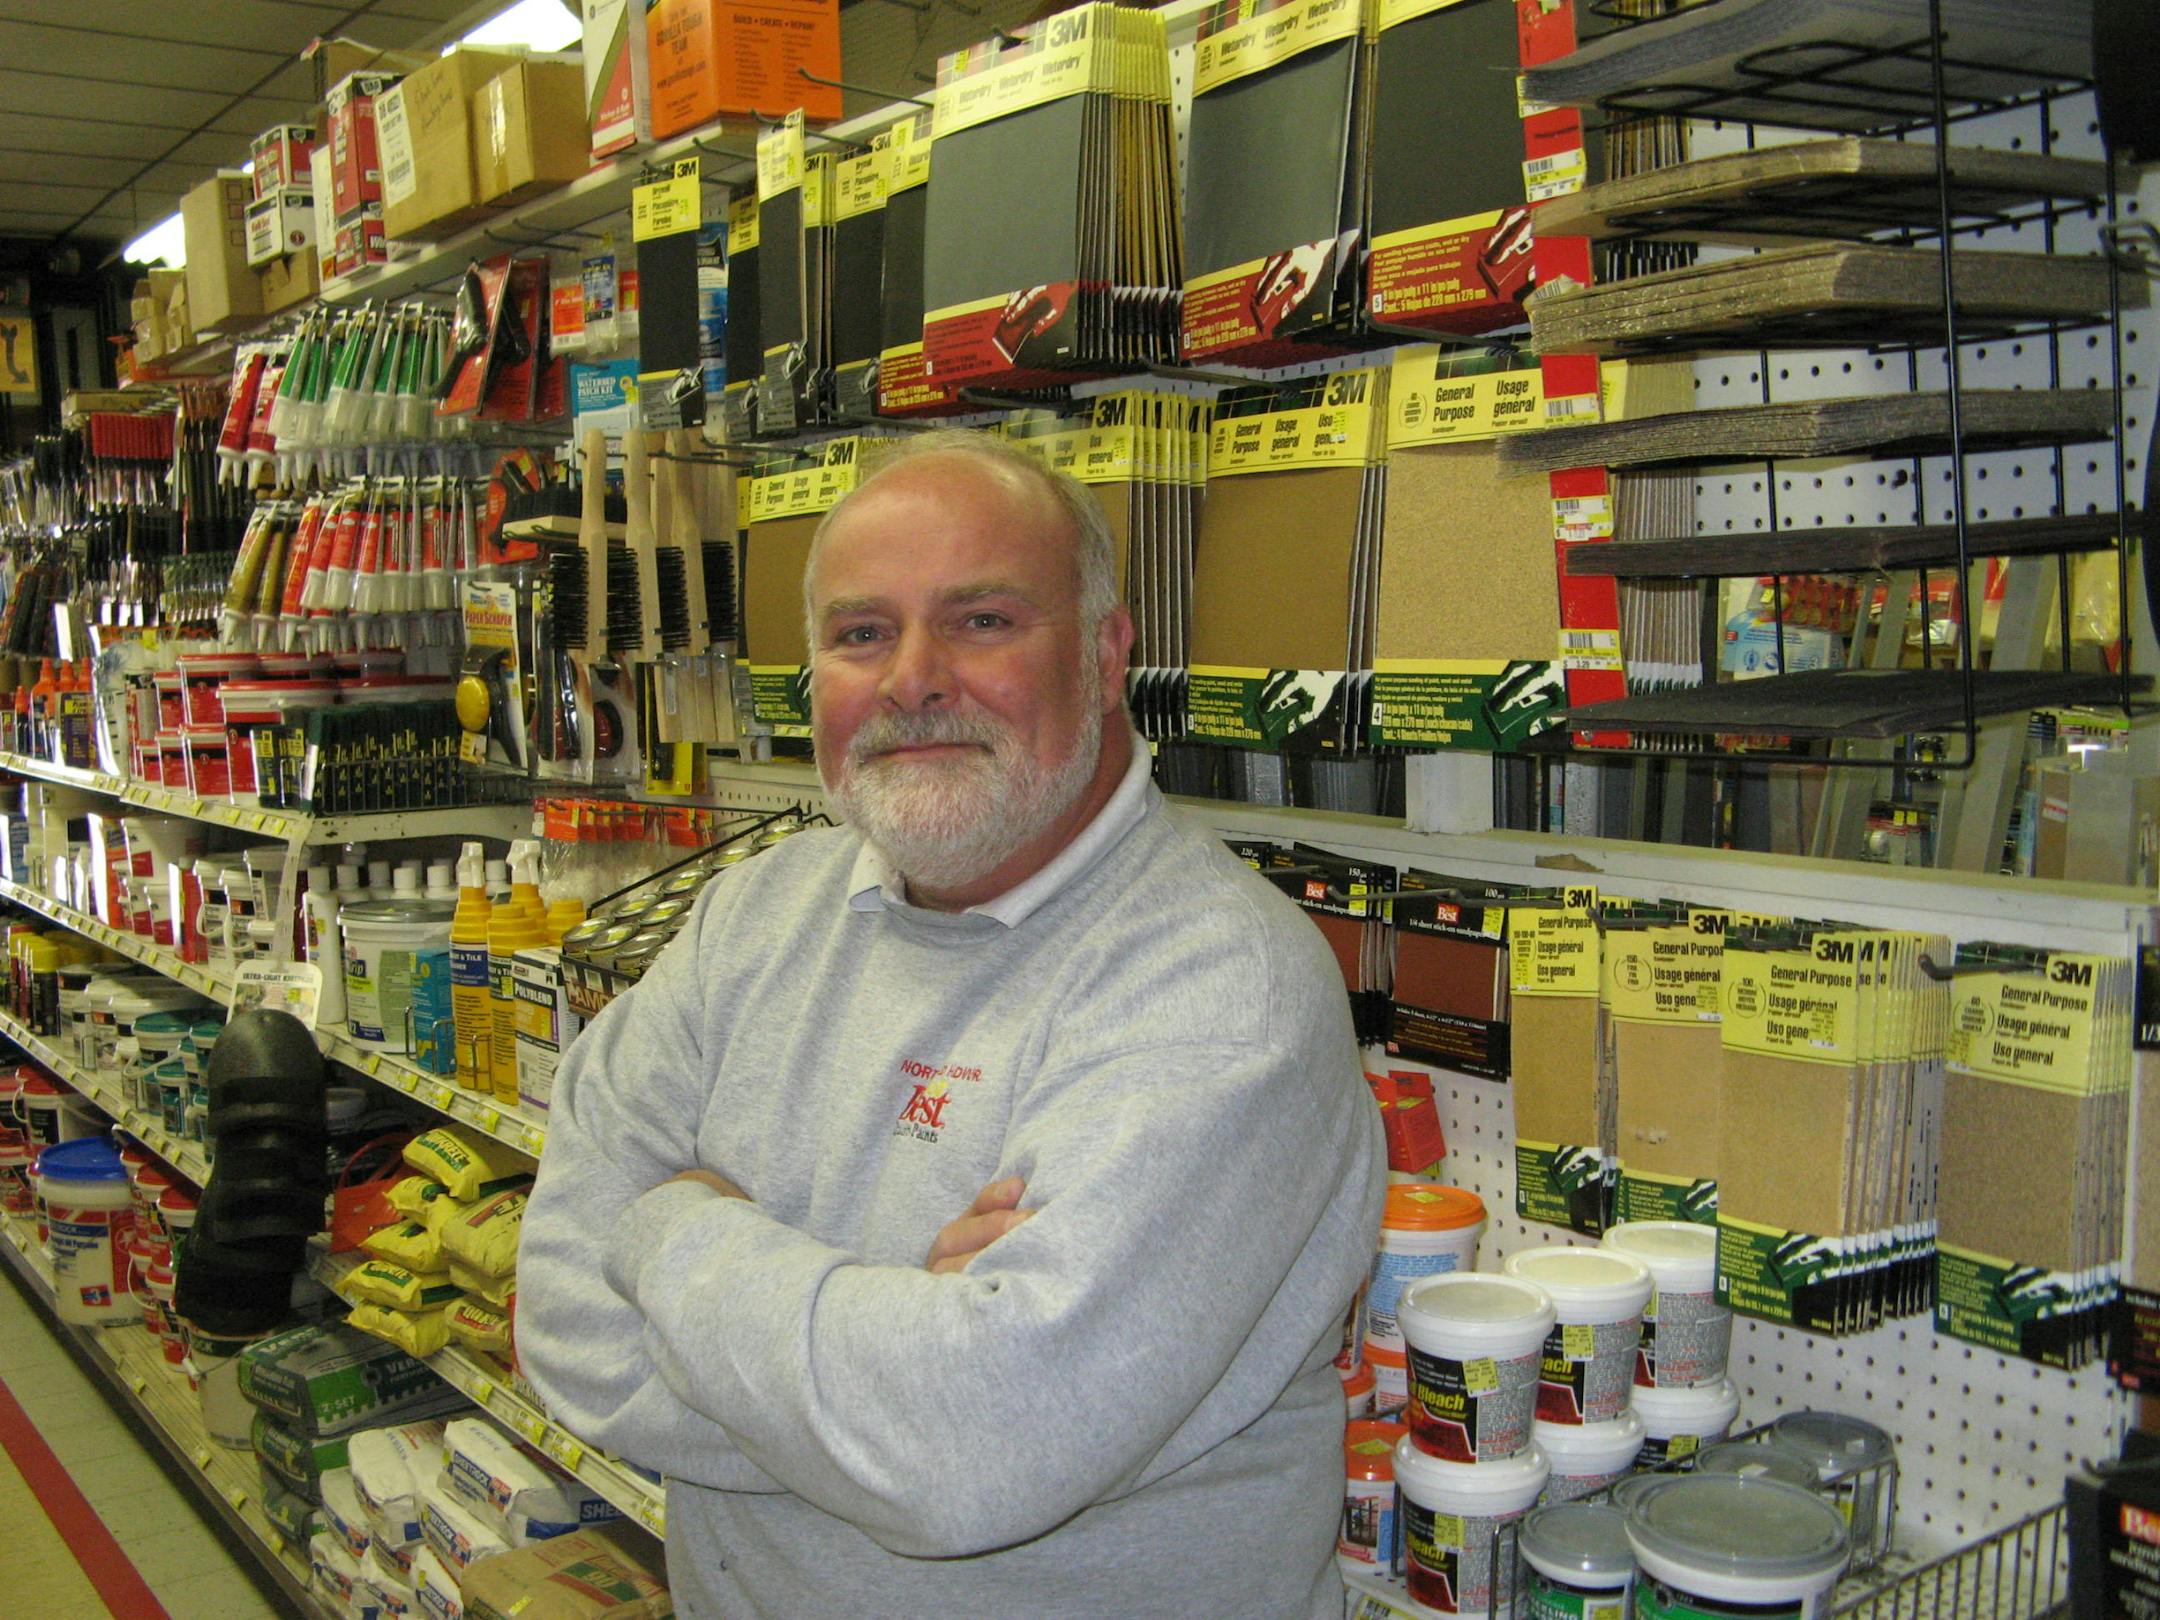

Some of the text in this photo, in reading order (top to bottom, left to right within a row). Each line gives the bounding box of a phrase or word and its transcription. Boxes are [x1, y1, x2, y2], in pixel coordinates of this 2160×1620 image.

[1050, 12, 1088, 47] 3M
[875, 134, 891, 151] 3M
[677, 161, 697, 178] 3M
[805, 156, 820, 172] 3M
[577, 376, 616, 389] WATERBED
[578, 385, 613, 397] PATCH KIT
[1328, 373, 1369, 407] 3M
[1436, 380, 1529, 403] General Usage
[1098, 397, 1126, 428] 3M
[1433, 404, 1476, 423] Purpose
[1493, 396, 1536, 419] général
[1318, 413, 1334, 428] Uso
[828, 441, 855, 467] 3M
[1306, 883, 1324, 899] Best
[1485, 887, 1498, 898] 100
[1567, 888, 1593, 909] 3M
[1437, 906, 1457, 922] Best
[1538, 916, 1593, 931] General Purpose
[1693, 914, 1729, 936] 3M
[1537, 940, 1557, 955] Usage
[1653, 941, 1689, 956] General
[1815, 938, 1854, 964] 3M
[466, 953, 482, 961] TILE
[1537, 963, 1576, 979] Uso general
[1654, 967, 1721, 984] Usage général
[1771, 965, 1853, 989] General Purpose
[2049, 960, 2093, 987] 3M
[514, 981, 553, 1006] POLYBLEND
[1655, 991, 1673, 1006] Uso
[1769, 992, 1798, 1011] Usage
[2001, 984, 2088, 1013] General Purpose
[1766, 1020, 1784, 1035] Uso
[1997, 1013, 2071, 1040] Usage général
[1993, 1041, 2054, 1066] Uso general
[1418, 1383, 1465, 1412] Bleach
